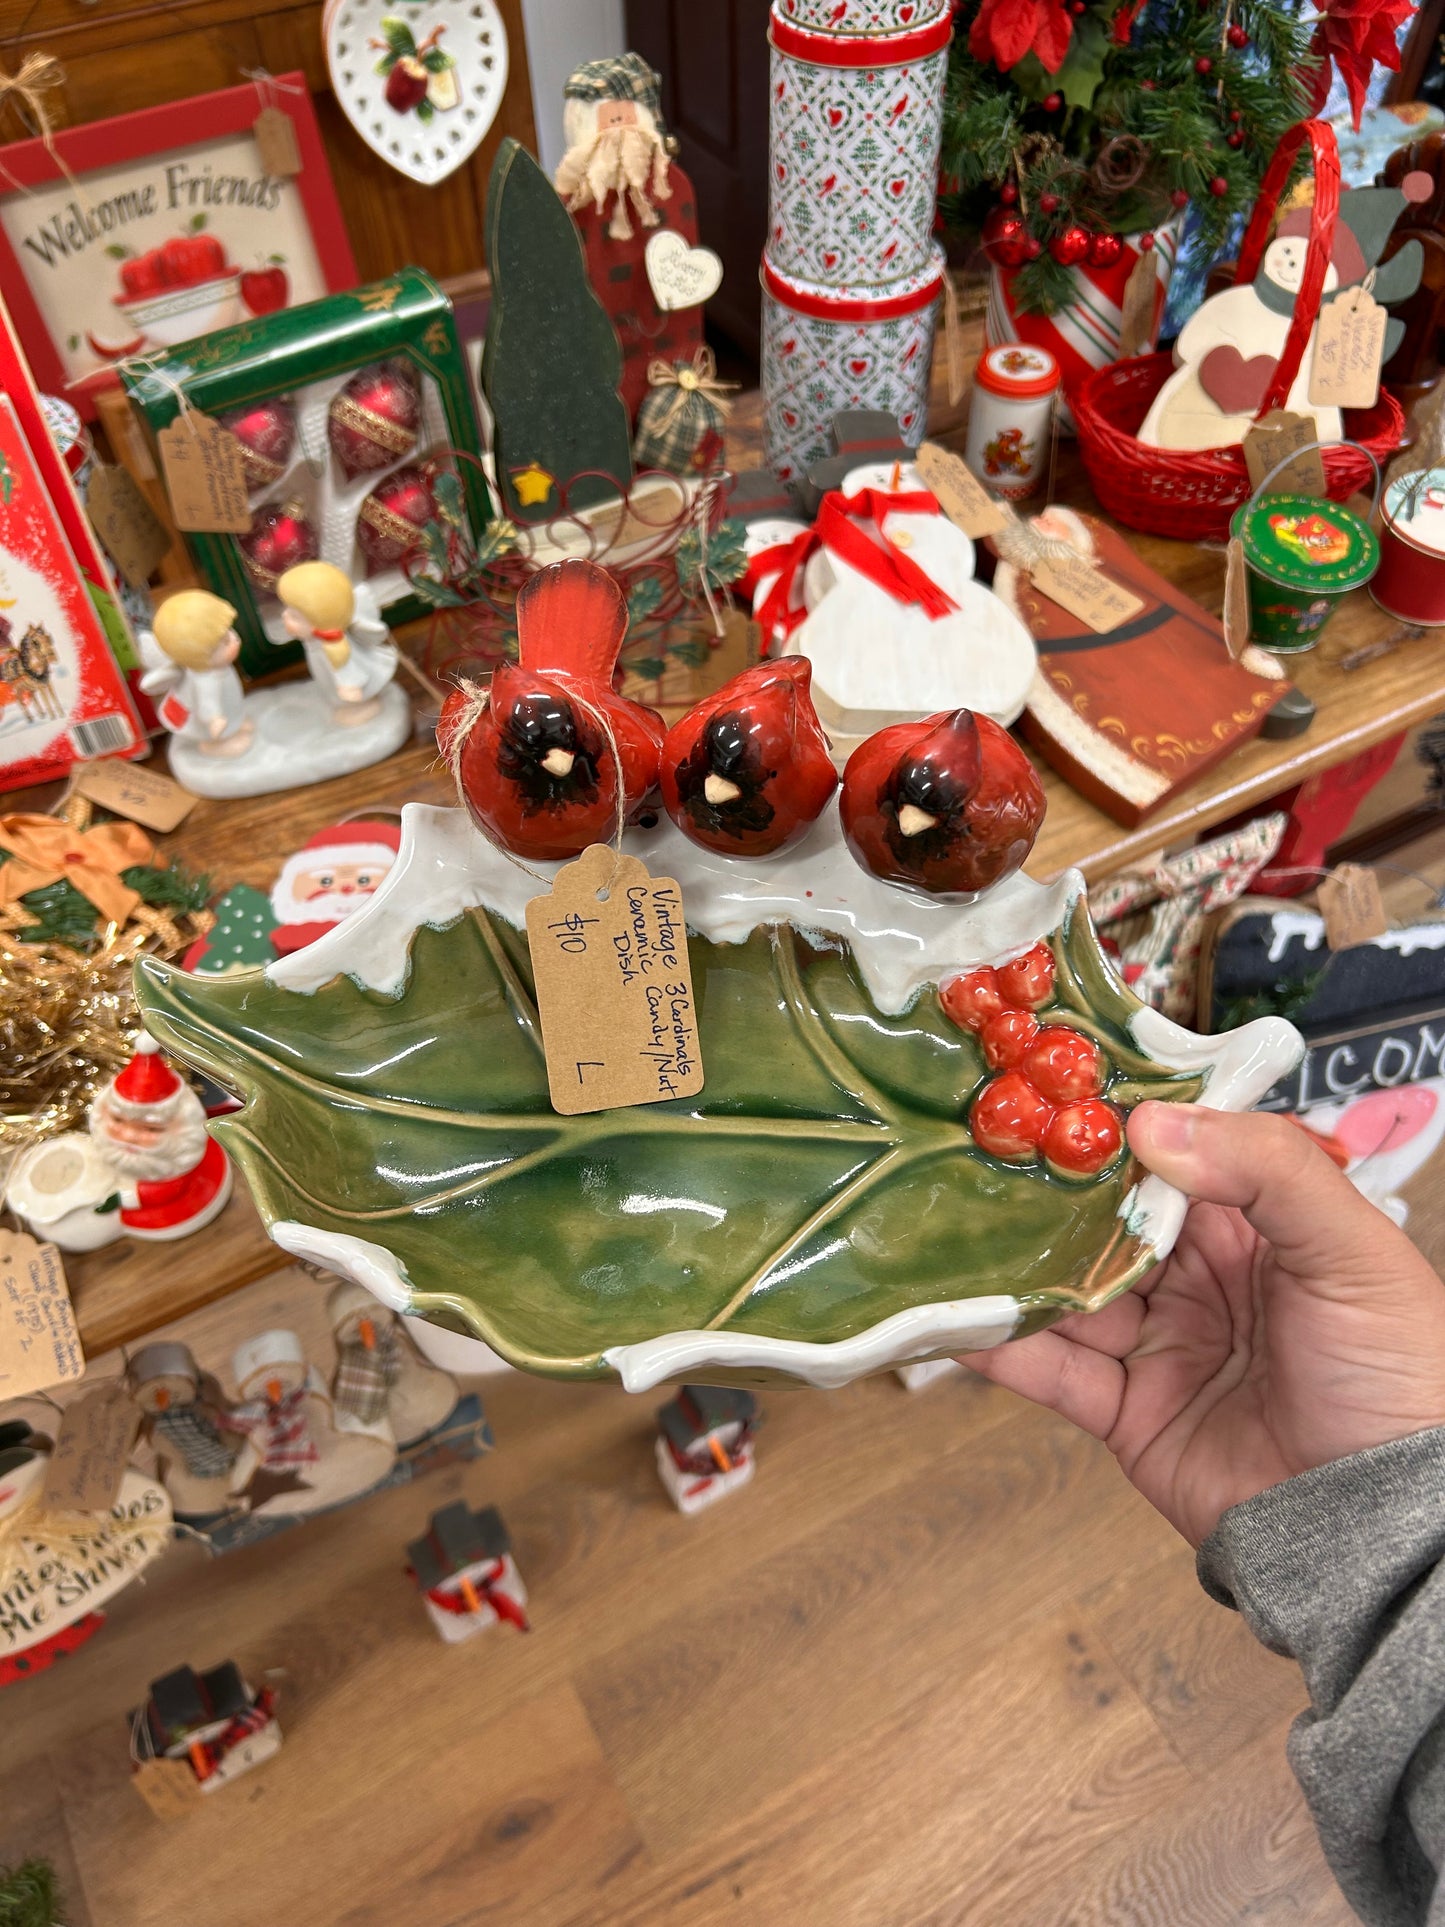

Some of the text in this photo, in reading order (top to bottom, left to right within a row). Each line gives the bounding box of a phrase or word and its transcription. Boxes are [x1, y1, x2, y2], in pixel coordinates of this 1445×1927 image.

[23, 161, 284, 268] Welcome Friends
[548, 913, 600, 953] $10
[613, 930, 634, 986] Dish
[627, 886, 653, 975] Ceramic
[651, 889, 696, 1076] Vintage 3 Cardinals
[576, 1061, 605, 1085] L
